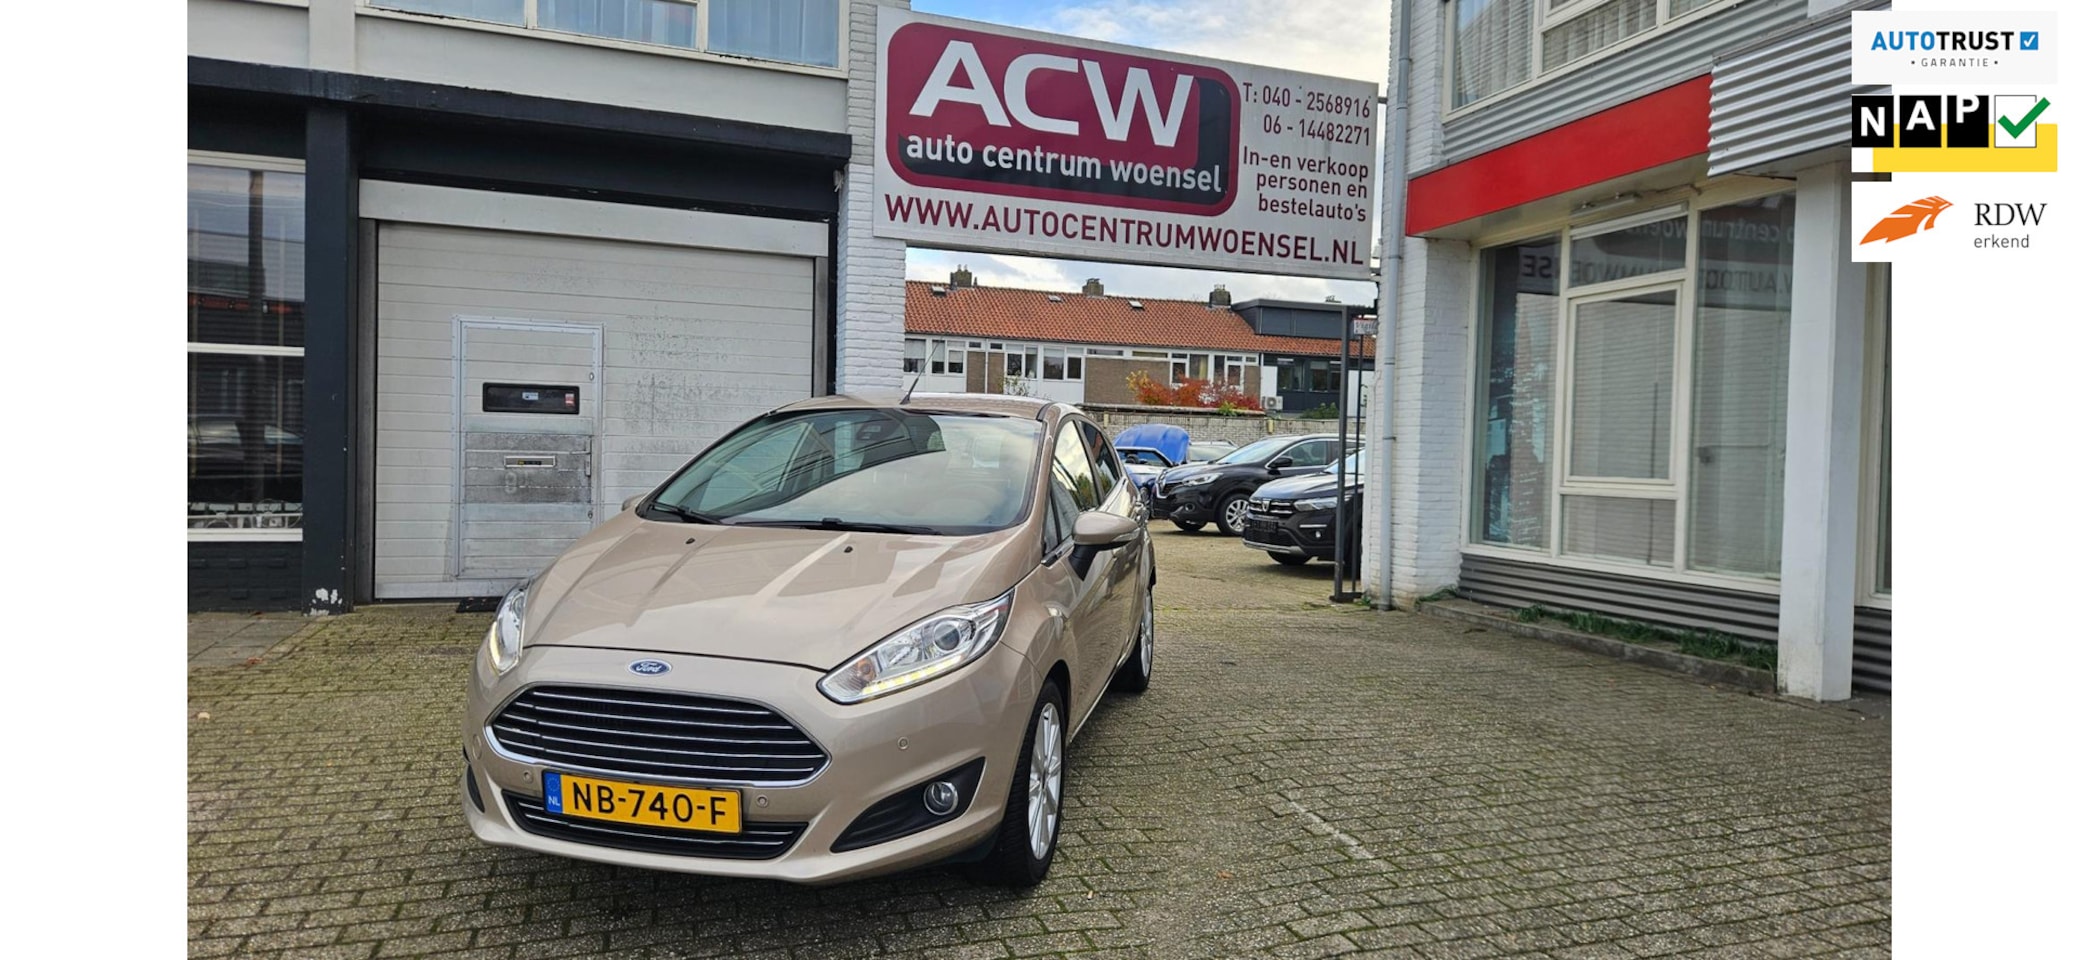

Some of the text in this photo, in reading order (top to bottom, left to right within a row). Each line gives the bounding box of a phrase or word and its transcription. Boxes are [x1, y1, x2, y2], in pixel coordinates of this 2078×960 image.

[909, 40, 1194, 147] ACW
[1243, 82, 1257, 103] T:
[1263, 85, 1290, 107] 040
[1307, 91, 1370, 118] 2568916
[1263, 114, 1281, 134] 06
[1299, 118, 1369, 146] 14482271
[906, 134, 1222, 193] auto centrum woensel
[1243, 145, 1368, 182] In-en verkoop
[1257, 172, 1367, 199] personen en
[1258, 193, 1366, 222] bestelauto's
[884, 193, 1364, 265] WWW.AUTOCENTRUMWOENSEL.NL
[548, 781, 727, 825] NL NB-740-F
